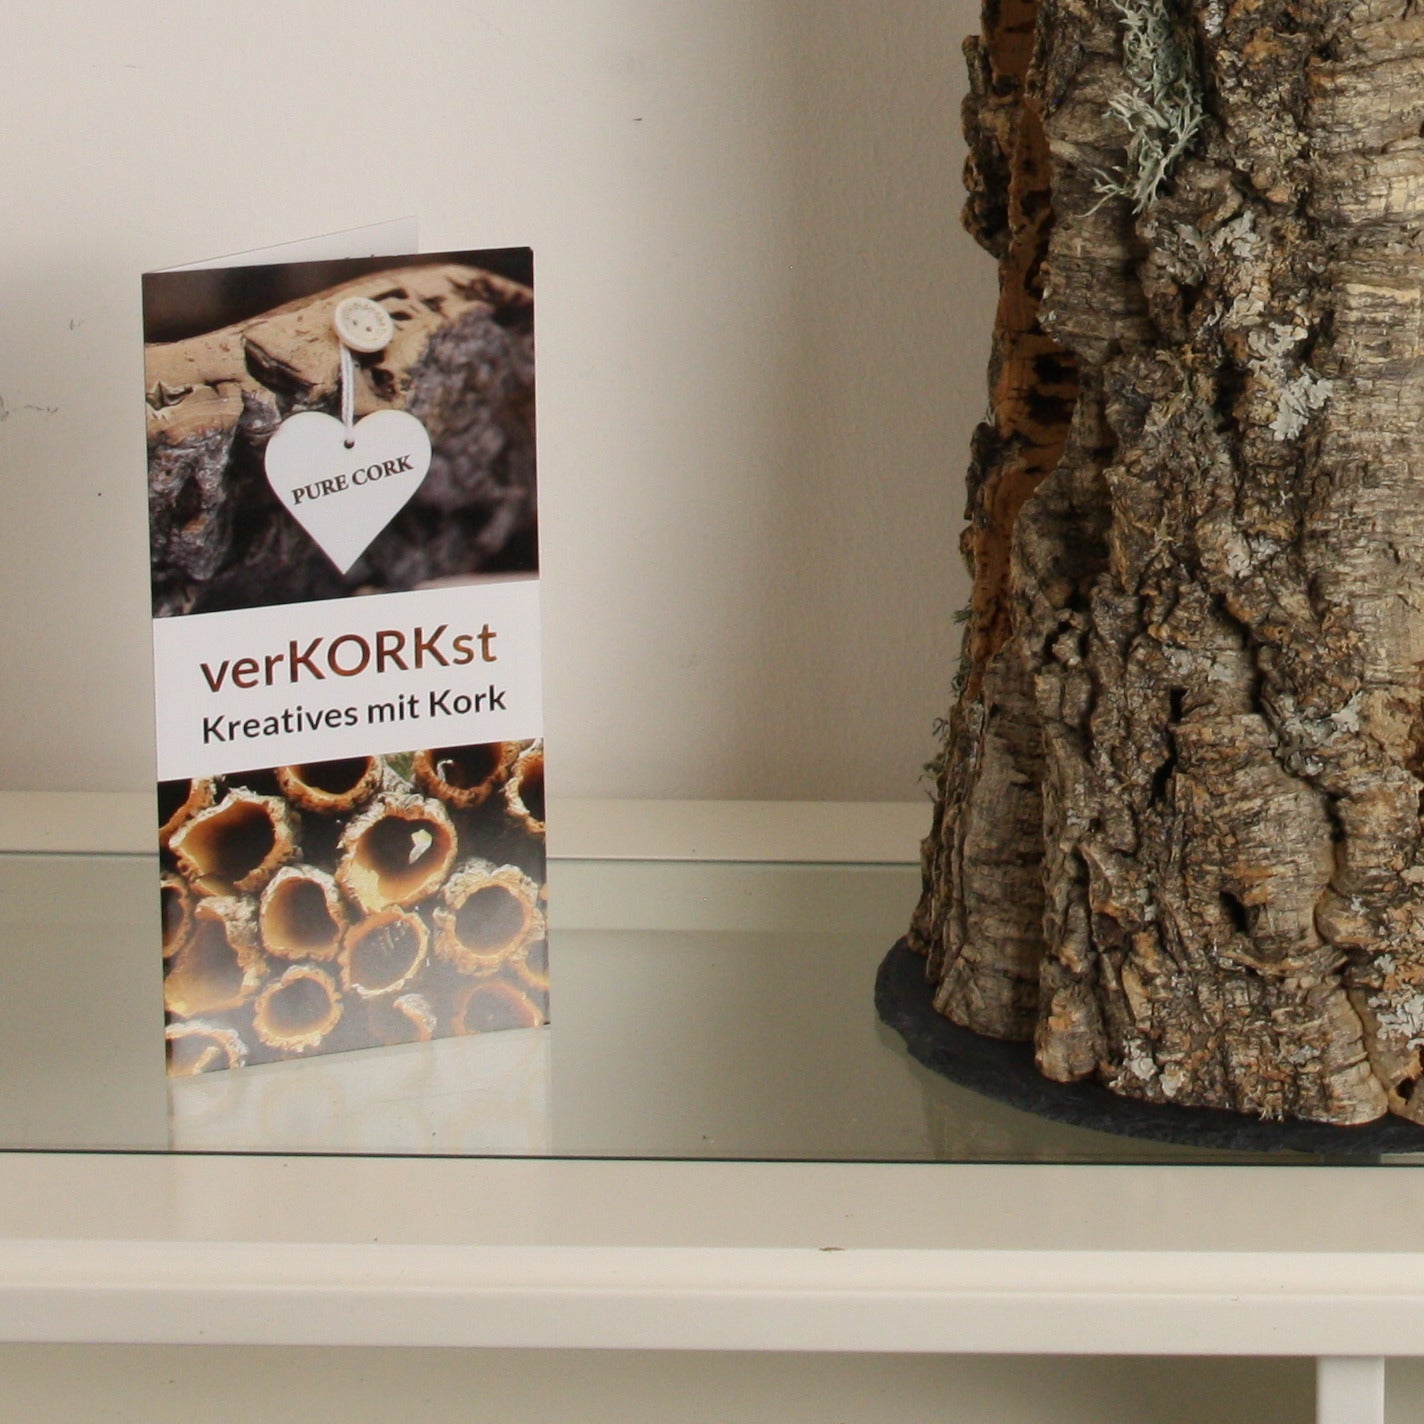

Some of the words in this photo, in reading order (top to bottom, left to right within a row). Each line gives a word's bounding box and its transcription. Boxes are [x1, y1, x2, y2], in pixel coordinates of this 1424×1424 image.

[291, 473, 349, 505] PURE
[351, 454, 414, 486] CORK
[200, 623, 498, 693] verKORKst
[202, 705, 358, 744] Kreatives
[367, 693, 420, 727] mit
[429, 685, 507, 717] Kork
